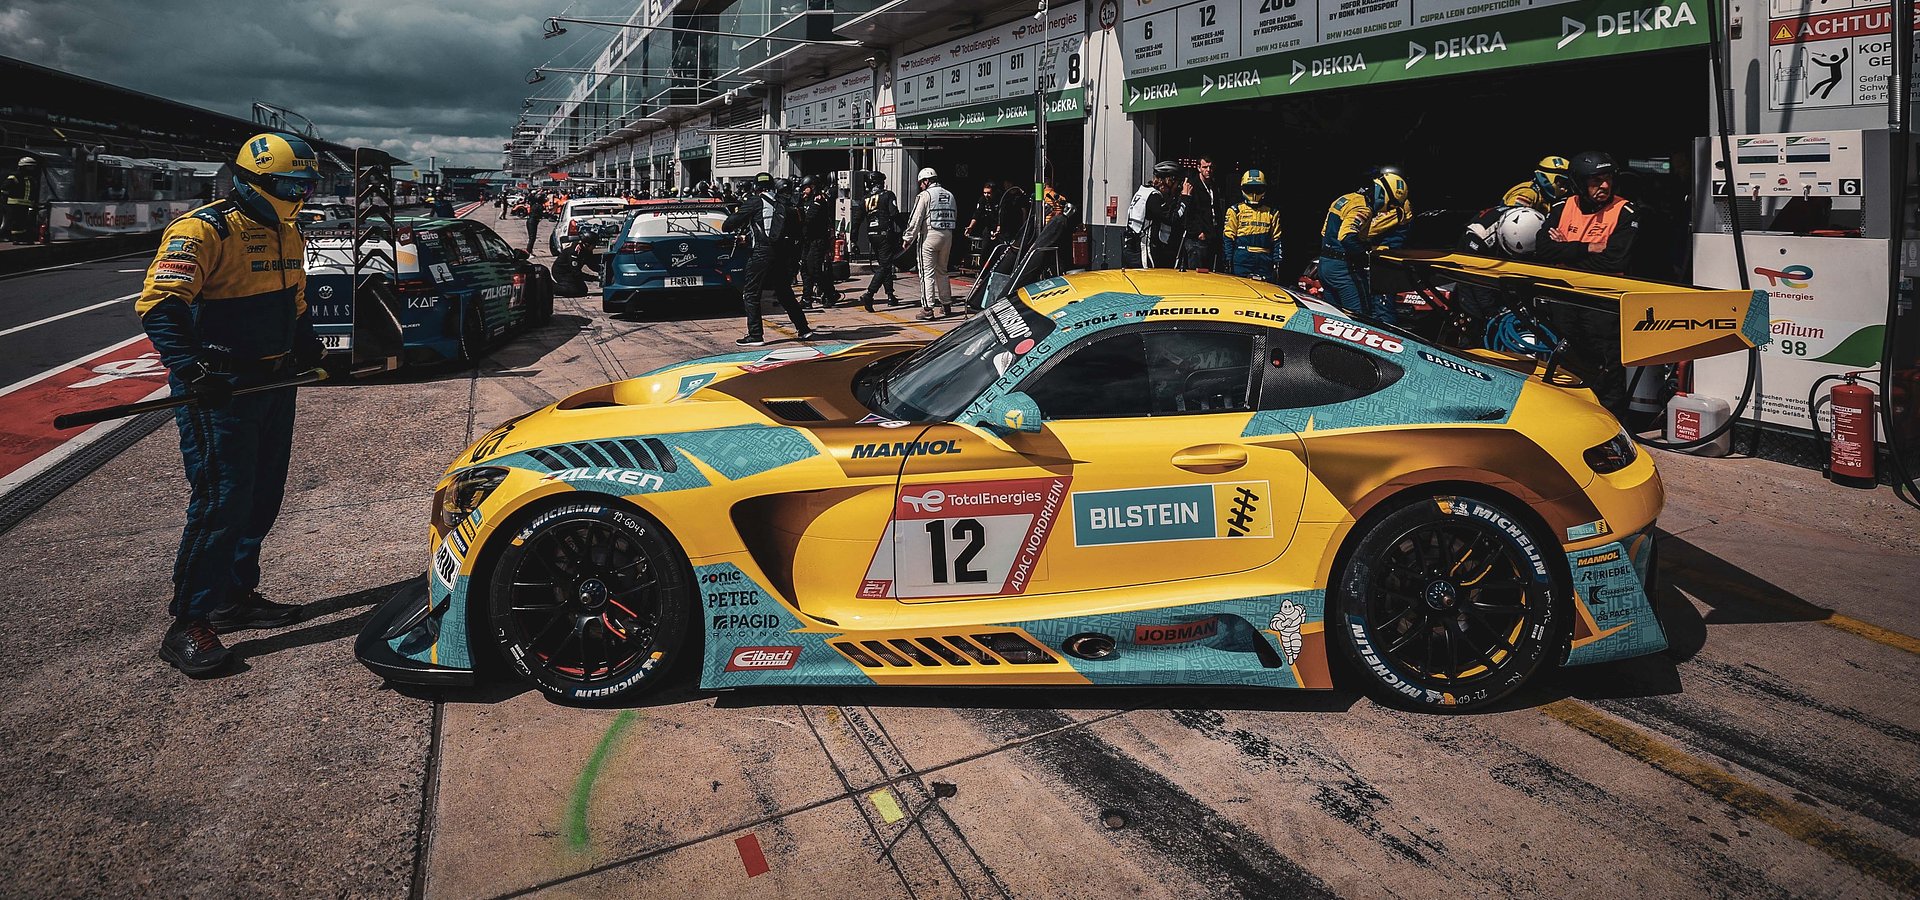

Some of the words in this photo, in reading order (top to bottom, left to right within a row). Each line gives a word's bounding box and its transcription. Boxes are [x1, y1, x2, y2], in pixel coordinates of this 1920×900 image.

[1200, 5, 1216, 27] 12
[1330, 12, 1338, 20] BY
[1356, 0, 1399, 15] MOTORSPORT
[1420, 12, 1444, 22] CUPRA
[1446, 8, 1465, 18] LEON
[1277, 14, 1296, 24] RACING
[1597, 2, 1696, 38] DEKRA
[1144, 21, 1153, 40] 6
[1190, 30, 1224, 42] MERCEDES-AMG
[1326, 31, 1342, 40] BMW
[1364, 22, 1387, 34] RACING
[1388, 20, 1402, 28] CUP
[962, 36, 1000, 54] TotalEnergies
[1134, 43, 1163, 53] MERCEDES-AMG
[1192, 40, 1204, 48] TEAM
[1204, 37, 1224, 46] BILSTEIN
[1256, 44, 1269, 53] BMW
[1434, 31, 1507, 60] DEKRA
[911, 54, 941, 69] TotalEnergies
[1010, 53, 1024, 70] 811
[1186, 54, 1219, 65] MERCEDES-AMG
[1312, 53, 1366, 78] DEKRA
[951, 69, 960, 84] 29
[978, 61, 992, 78] 310
[1069, 54, 1080, 84] 8
[1218, 69, 1261, 90] DEKRA
[1143, 82, 1178, 100] DEKRA
[1006, 106, 1028, 118] DEKRA
[1052, 98, 1078, 112] DEKRA
[966, 112, 986, 124] DEKRA
[1716, 182, 1726, 194] 7
[1844, 180, 1856, 194] 6
[84, 212, 136, 228] TotalEnergies
[159, 262, 196, 274] JOBMAN
[481, 284, 512, 300] FALKEN
[312, 304, 350, 316] MAKS
[1136, 308, 1220, 318] MARCIELLO
[1244, 310, 1286, 322] ELLIS
[1074, 313, 1118, 330] STOLZ
[1324, 318, 1368, 333] sport
[1668, 318, 1736, 330] AMG
[1320, 324, 1404, 354] auto
[1781, 340, 1807, 356] 98
[1426, 353, 1484, 380] BASTUCK
[966, 342, 1052, 418] MERBAG
[851, 440, 962, 458] MANNOL
[543, 468, 664, 490] FALKEN
[948, 490, 1042, 506] TotalEnergies
[532, 504, 601, 529] MICHELIN
[1028, 479, 1064, 554] NORDRHEIN
[1090, 502, 1200, 530] BILSTEIN
[1472, 505, 1546, 576] MICHELIN
[925, 518, 988, 583] 12
[1578, 552, 1619, 566] MANNOL
[702, 571, 741, 584] sonic
[1010, 555, 1033, 592] ADAC
[1600, 565, 1630, 579] RIEDEL
[708, 591, 758, 608] PETEC
[730, 614, 780, 628] PAGID
[1140, 622, 1217, 641] JOBMAN
[734, 650, 790, 666] Eibach
[1351, 624, 1423, 699] MICHELIN
[575, 670, 644, 698] MICHELIN
